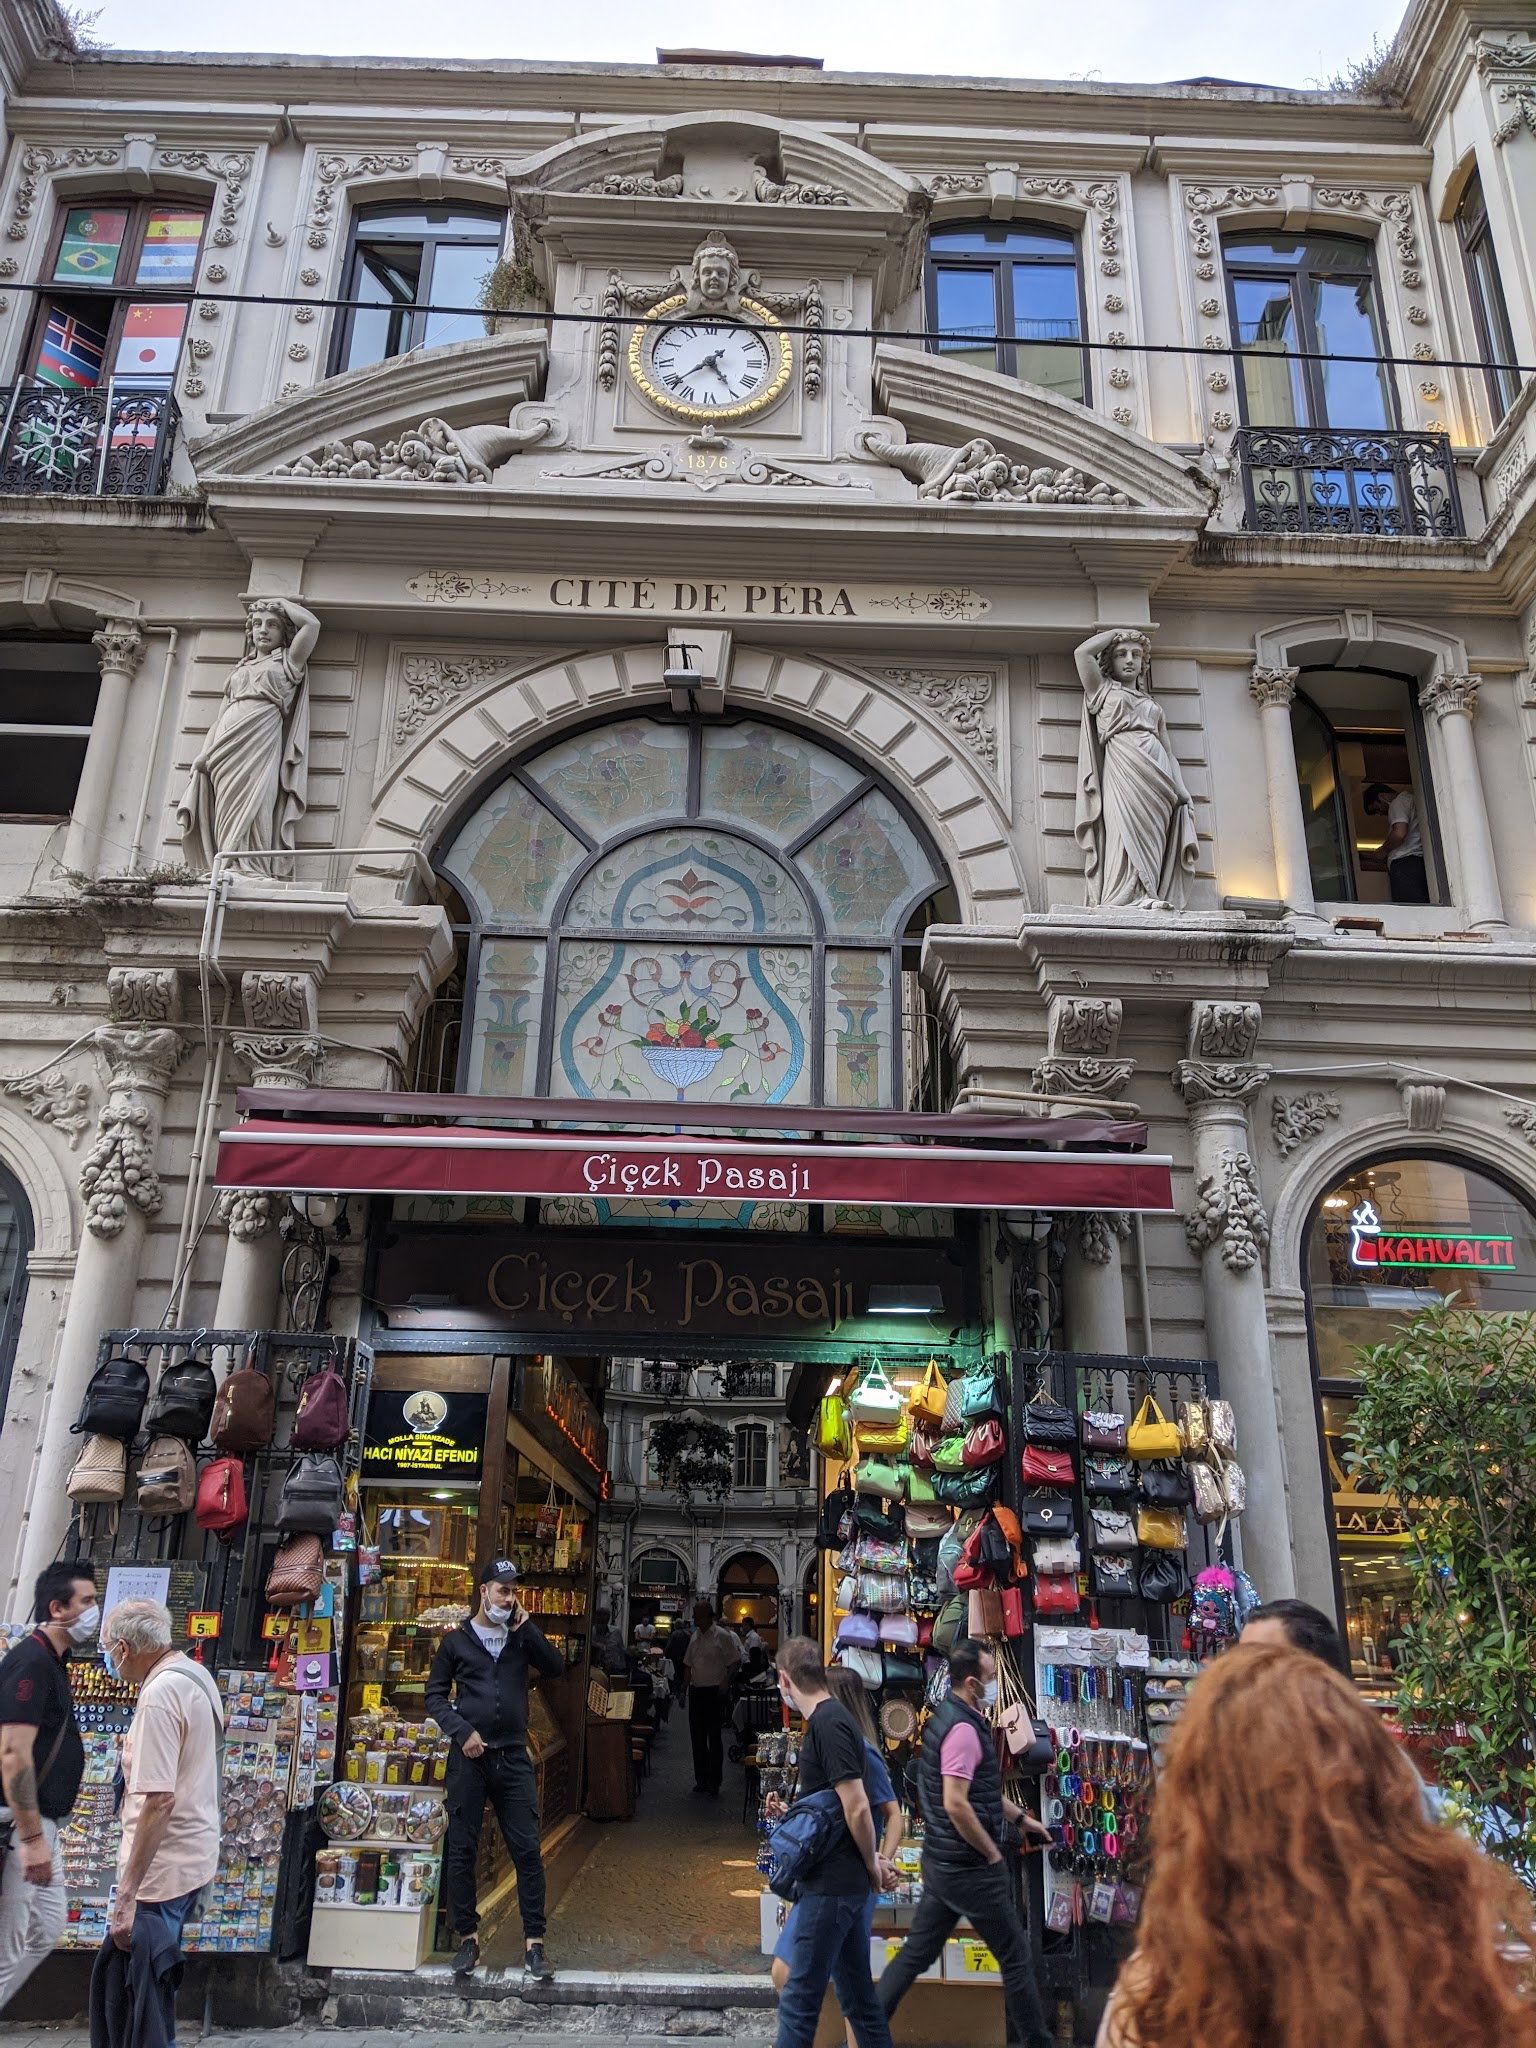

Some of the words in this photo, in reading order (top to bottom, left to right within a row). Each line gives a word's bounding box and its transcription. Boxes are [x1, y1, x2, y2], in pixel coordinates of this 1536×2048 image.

[688, 454, 728, 469] 1876
[550, 578, 656, 609] CITÉ
[673, 583, 727, 612] DE
[743, 582, 858, 616] PÉRA
[582, 1153, 681, 1192] Çiçek
[697, 1158, 810, 1198] Pasajı
[1377, 1237, 1515, 1265] KAHVALTI
[388, 1434, 414, 1445] MOLLA
[363, 1447, 392, 1460] HACI
[394, 1445, 433, 1461] NİYAZİ
[434, 1447, 478, 1463] EFENDİ
[196, 1623, 205, 1635] 5
[973, 1958, 982, 1971] 7
